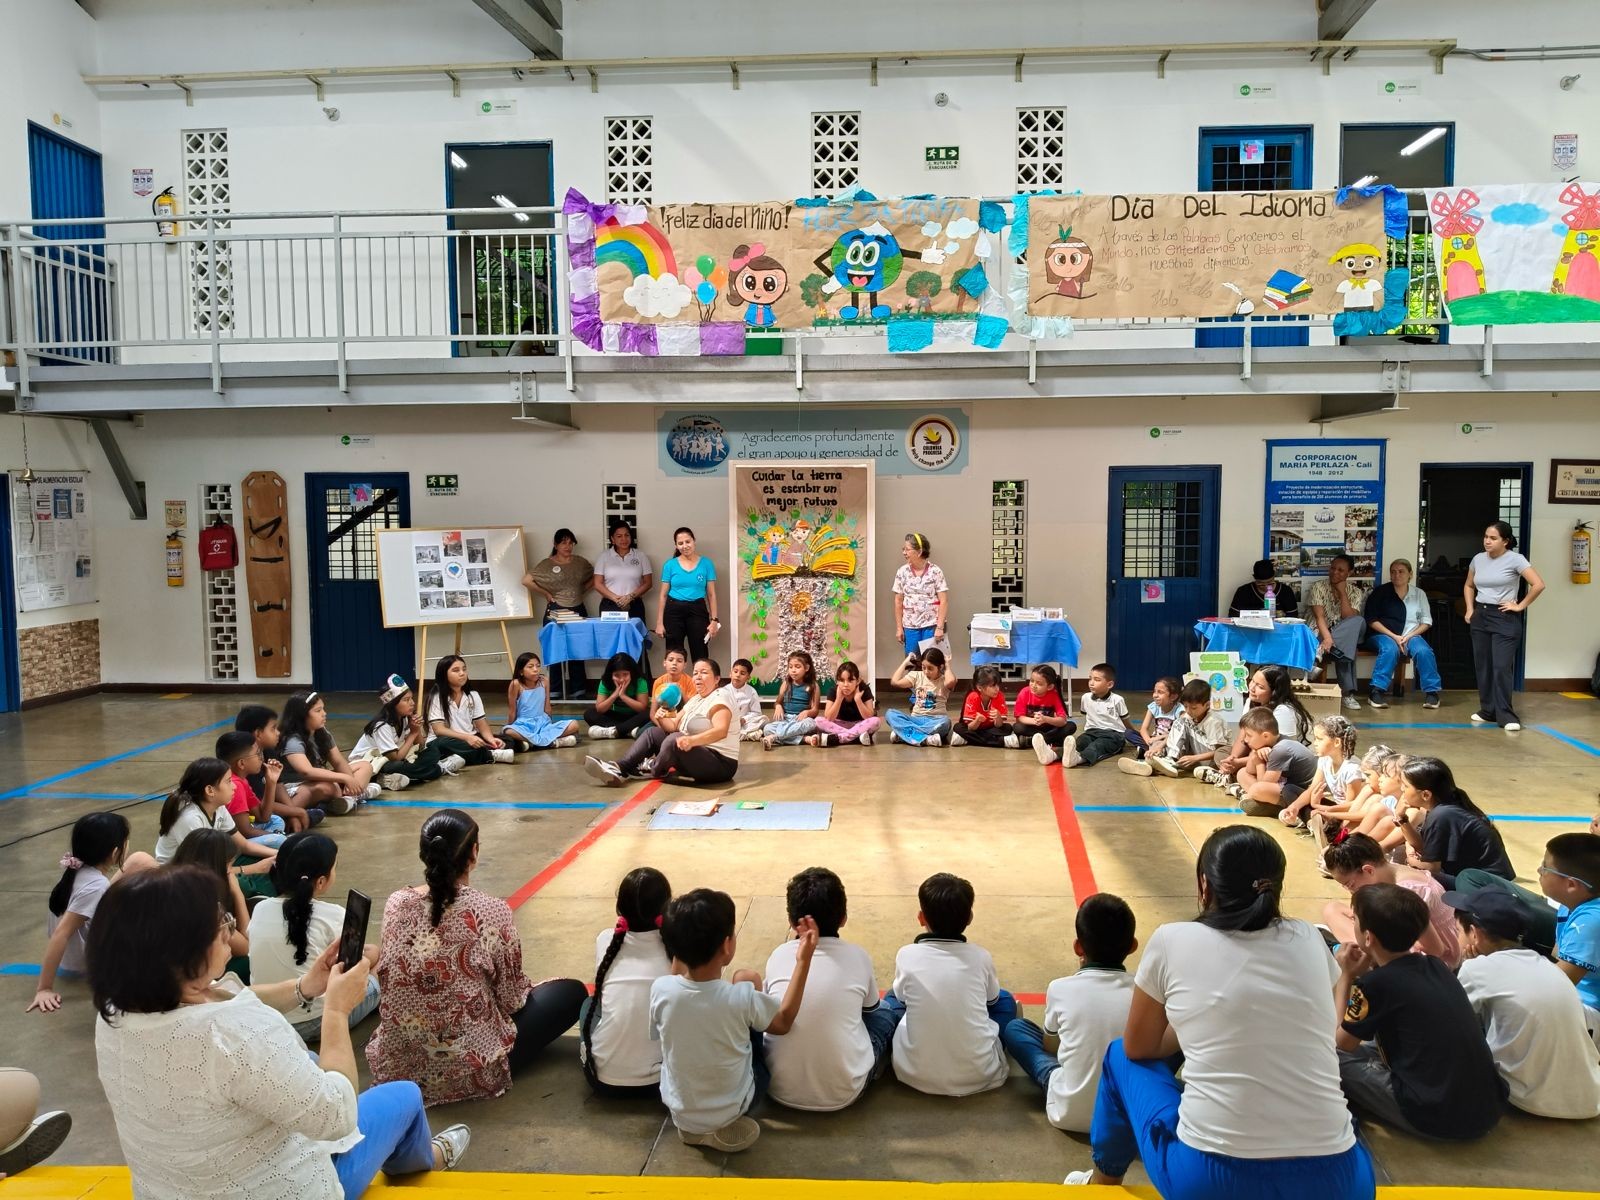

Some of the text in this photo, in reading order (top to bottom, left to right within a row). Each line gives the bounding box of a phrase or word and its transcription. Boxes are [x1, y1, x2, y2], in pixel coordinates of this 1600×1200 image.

[725, 205, 747, 230] del
[741, 428, 895, 448] Agradecemos profundamente
[737, 446, 746, 459] el
[748, 450, 772, 460] gran
[774, 450, 808, 460] apoyo
[819, 444, 883, 460] generosidad
[885, 444, 899, 458] de
[792, 470, 804, 480] la
[763, 486, 775, 494] es
[823, 486, 838, 494] un
[766, 498, 798, 512] mejor
